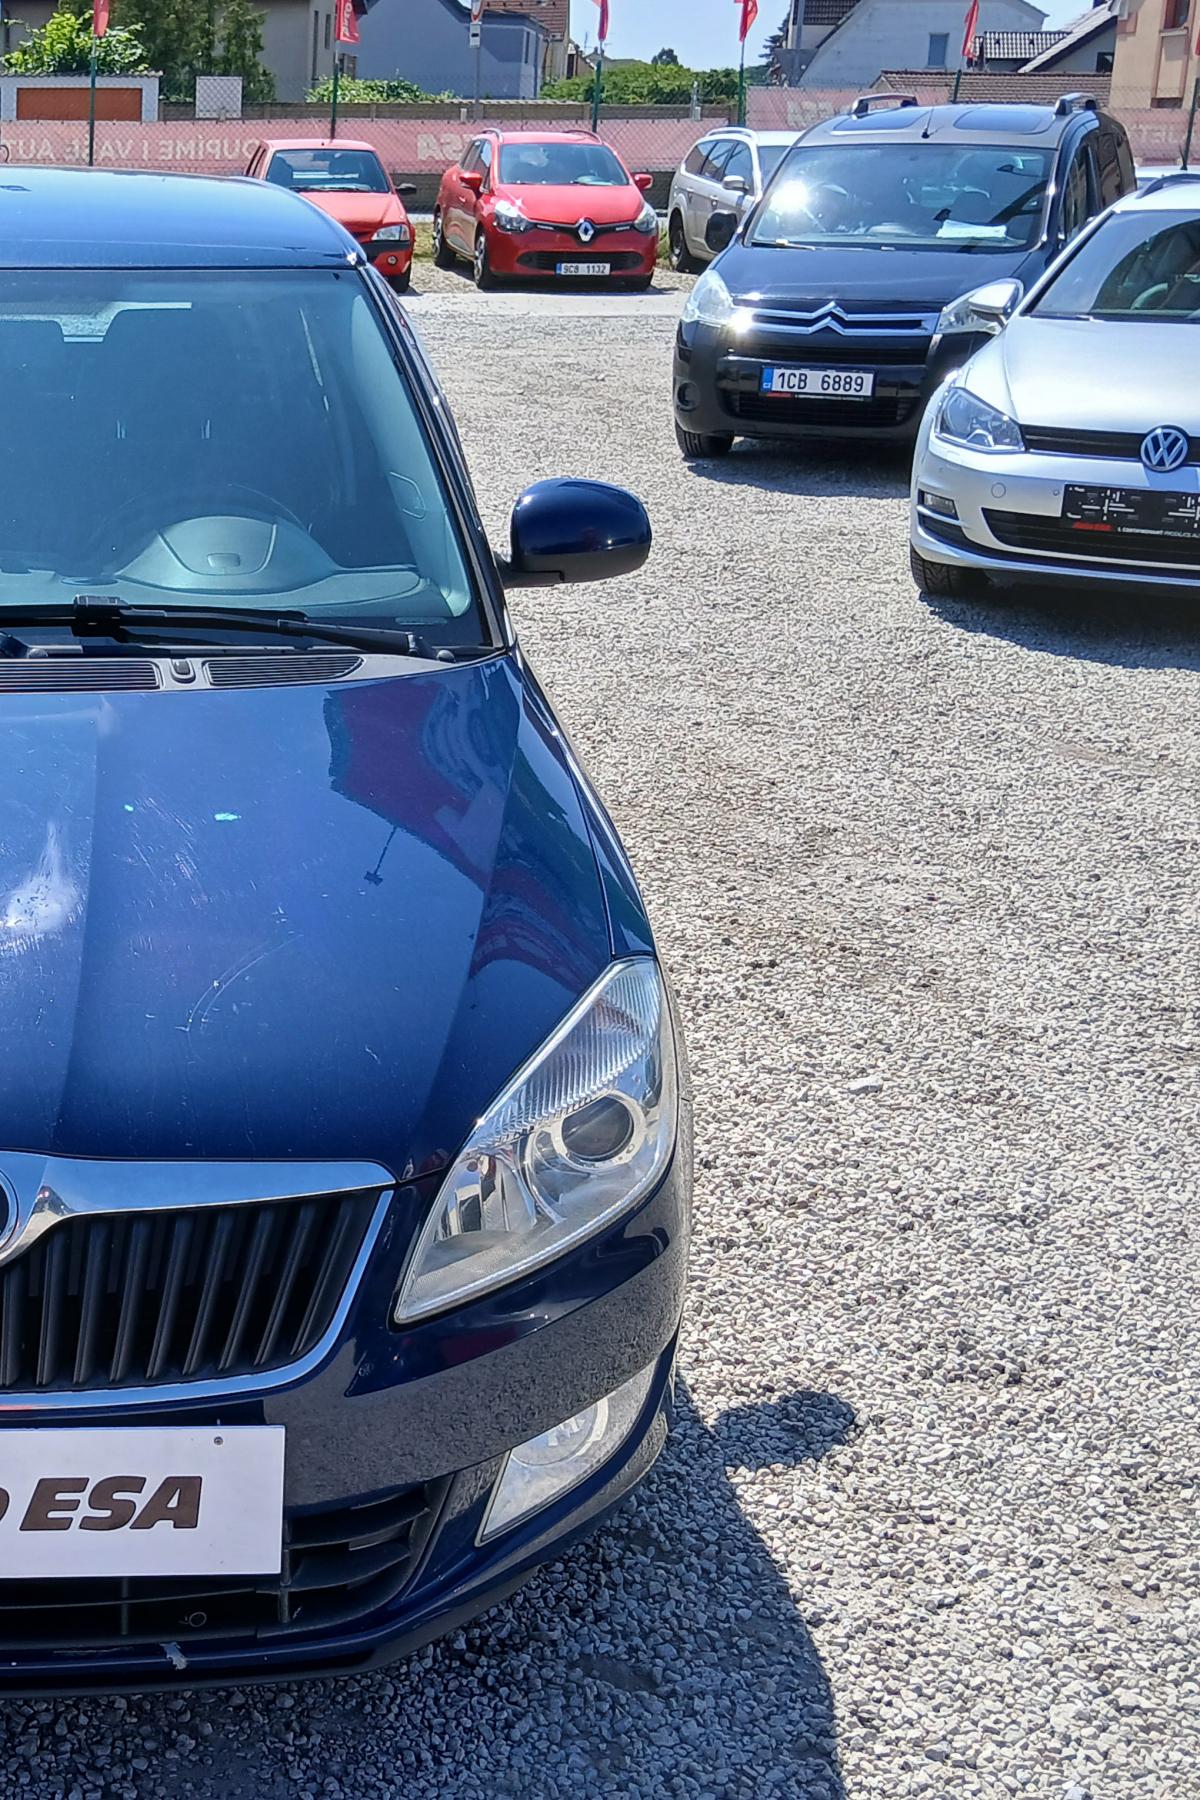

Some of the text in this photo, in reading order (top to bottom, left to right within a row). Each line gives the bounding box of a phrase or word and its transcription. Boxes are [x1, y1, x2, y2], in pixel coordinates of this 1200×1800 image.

[586, 262, 607, 274] 1132
[778, 371, 808, 391] 1CB
[820, 374, 865, 393] 6889
[20, 1475, 203, 1532] ESA
